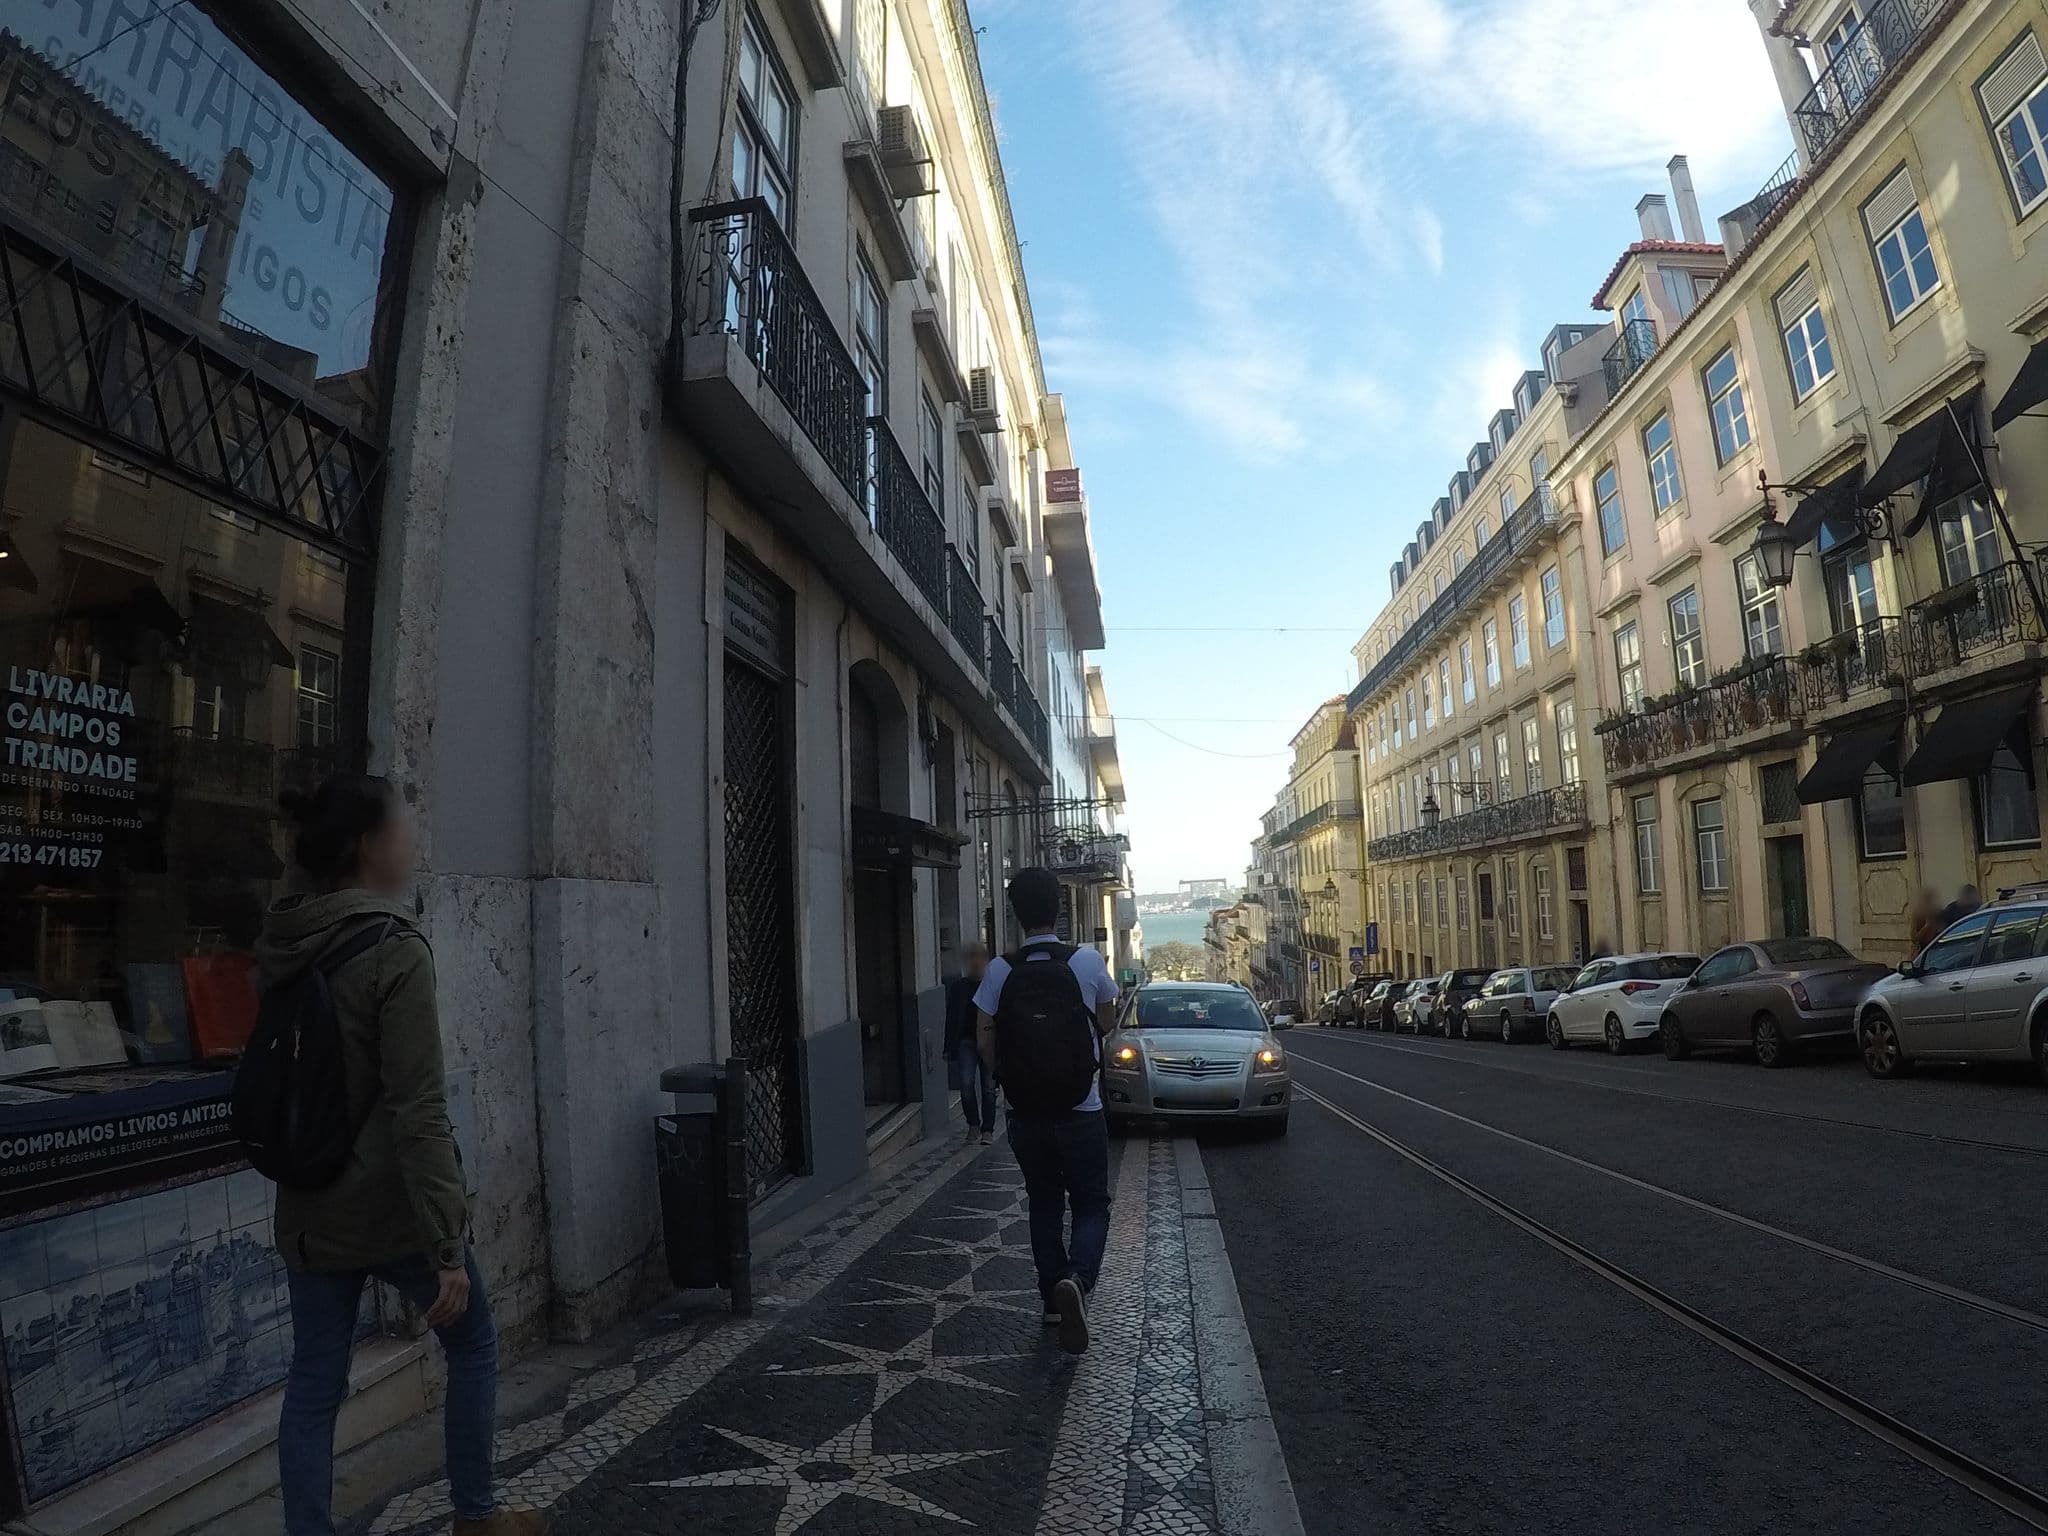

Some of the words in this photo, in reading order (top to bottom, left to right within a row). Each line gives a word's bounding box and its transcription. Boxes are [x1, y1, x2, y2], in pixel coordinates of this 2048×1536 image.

[9, 665, 136, 717] LIVRARIA
[6, 702, 121, 747] CAMPOS
[5, 737, 137, 782] TRINDADE
[2, 773, 16, 784] DE
[21, 775, 79, 793] BERNARDO
[83, 784, 136, 800] TRINDADE
[0, 842, 32, 864] 213
[35, 844, 103, 868] 471857
[0, 1122, 115, 1159] COMPRAMOS
[119, 1111, 177, 1138] LIVROS
[0, 1160, 48, 1177] GRANDES
[60, 1148, 107, 1167] PEQUENAS
